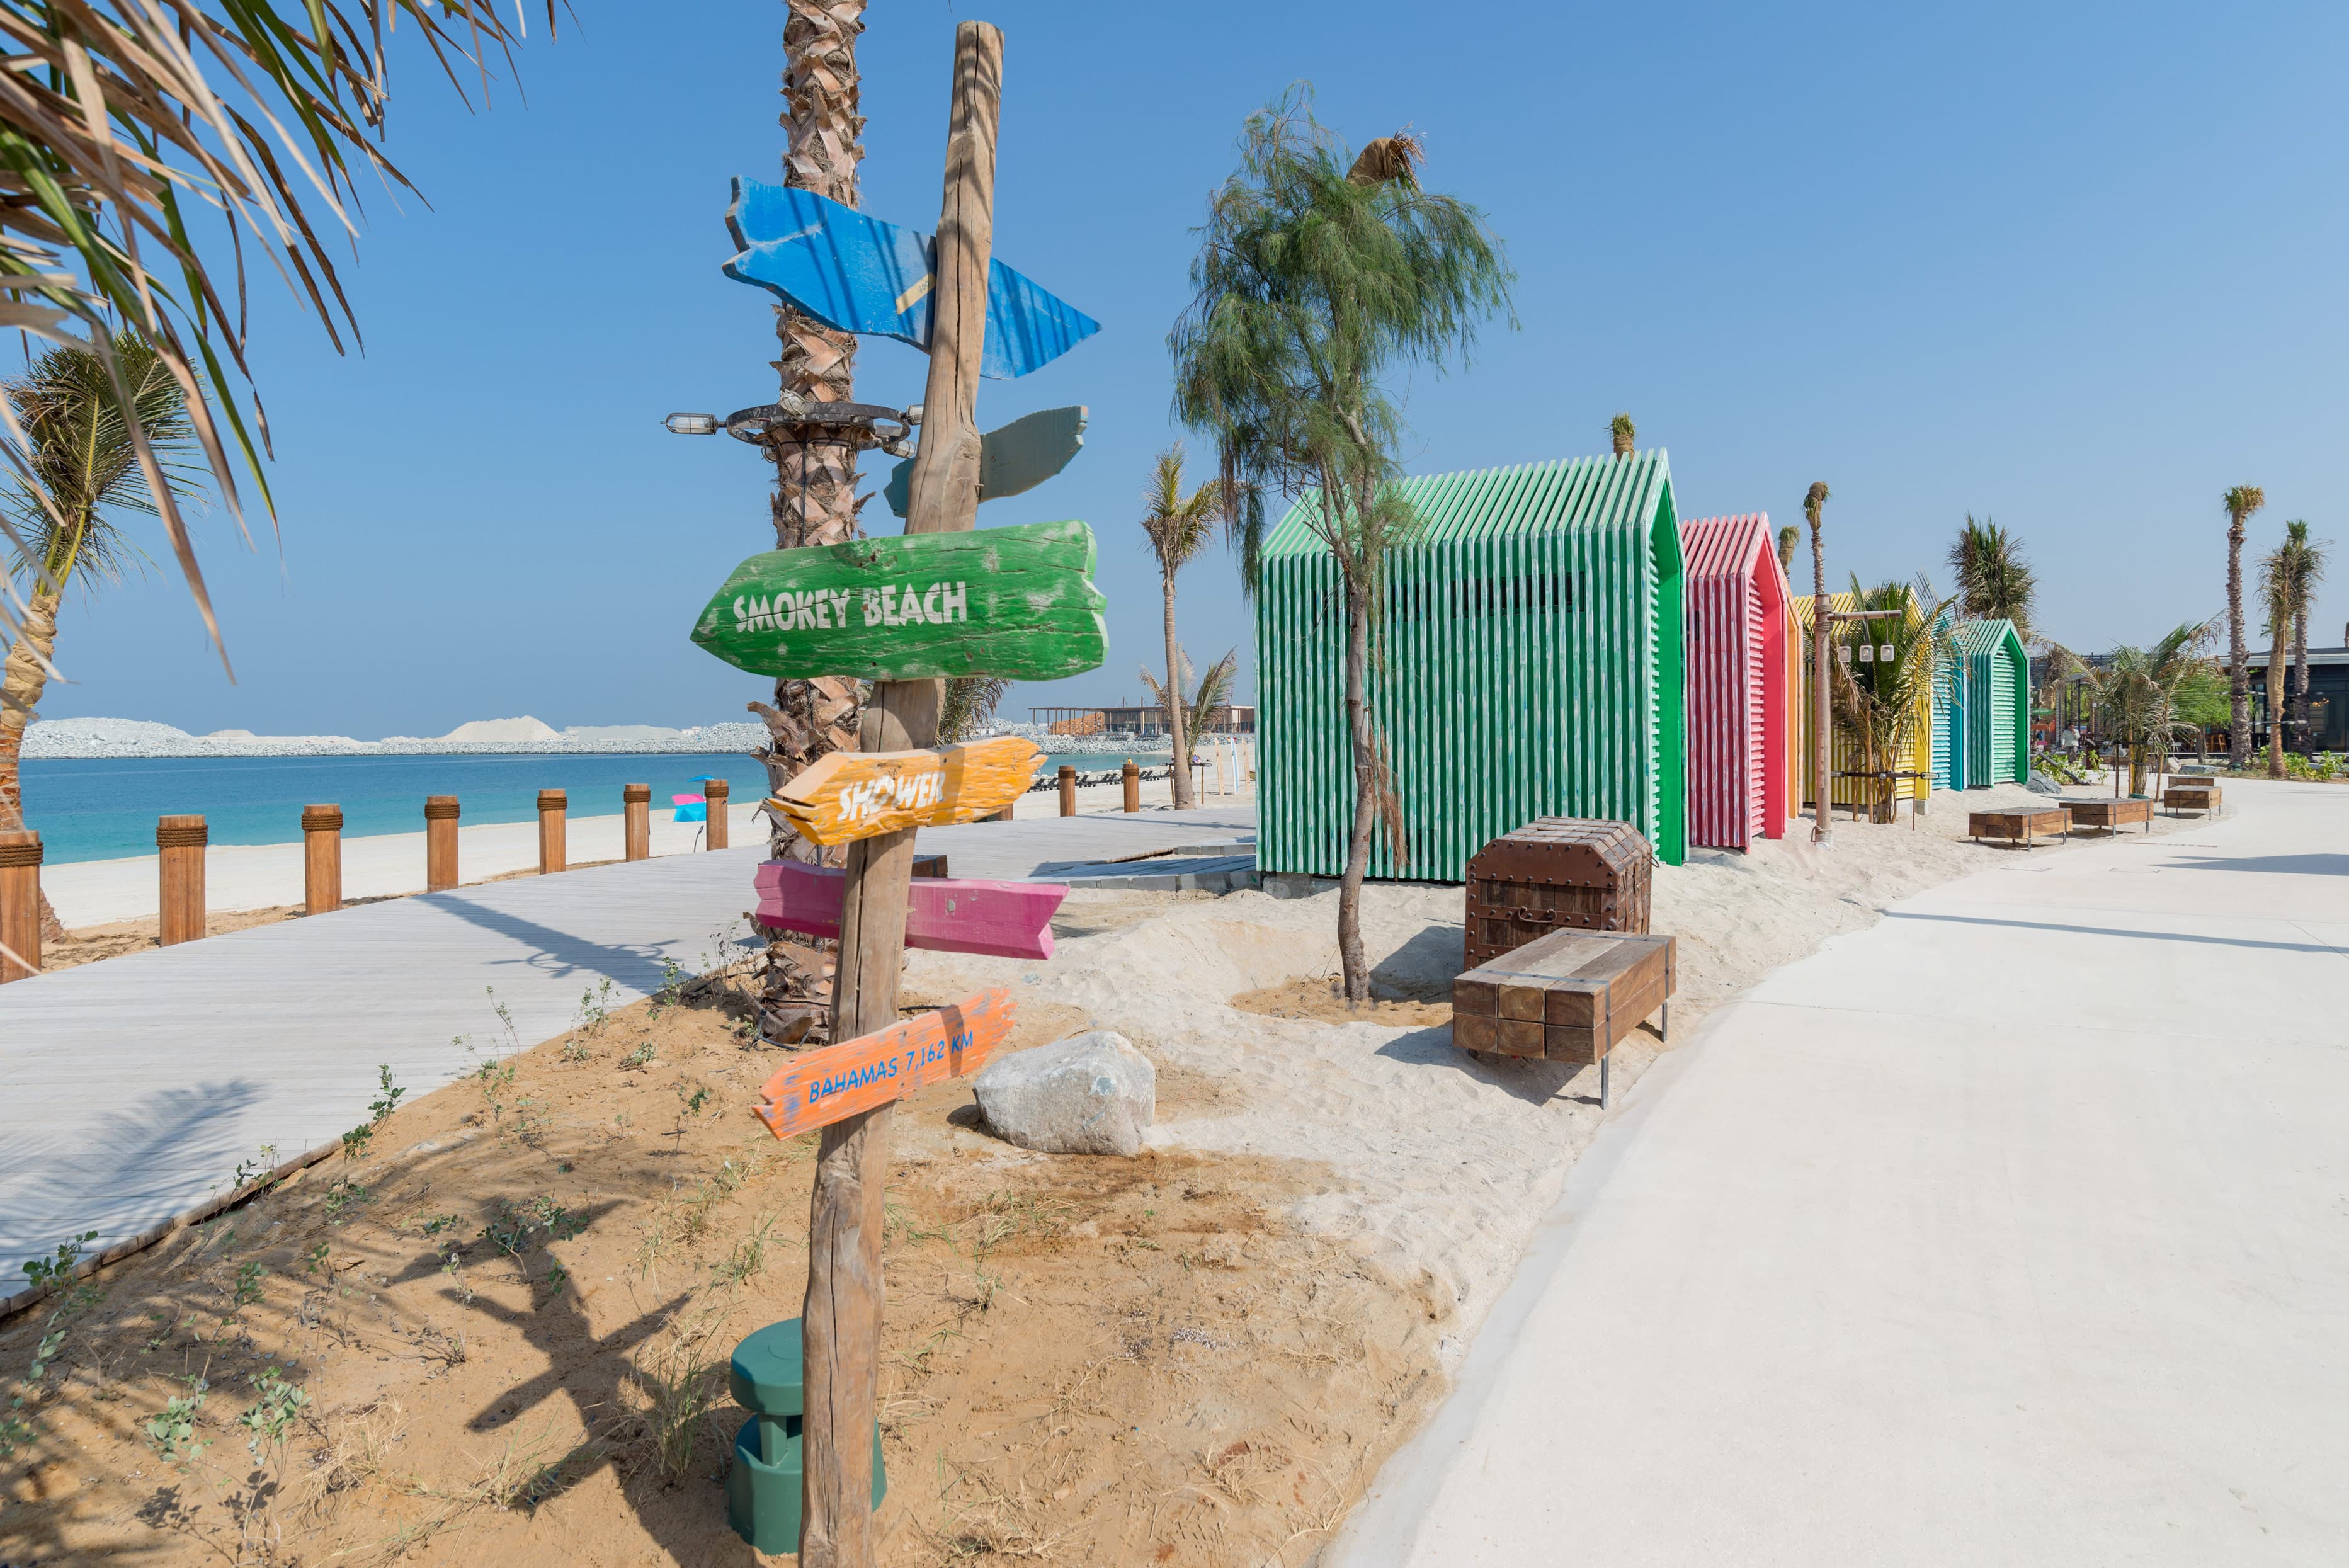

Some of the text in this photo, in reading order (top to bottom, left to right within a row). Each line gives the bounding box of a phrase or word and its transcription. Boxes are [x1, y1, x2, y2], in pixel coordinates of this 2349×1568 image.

[733, 581, 967, 633] SMOKEY BEACH
[838, 771, 946, 821] SHOWER
[809, 1031, 973, 1103] BAHAMAS 7,162 KM
